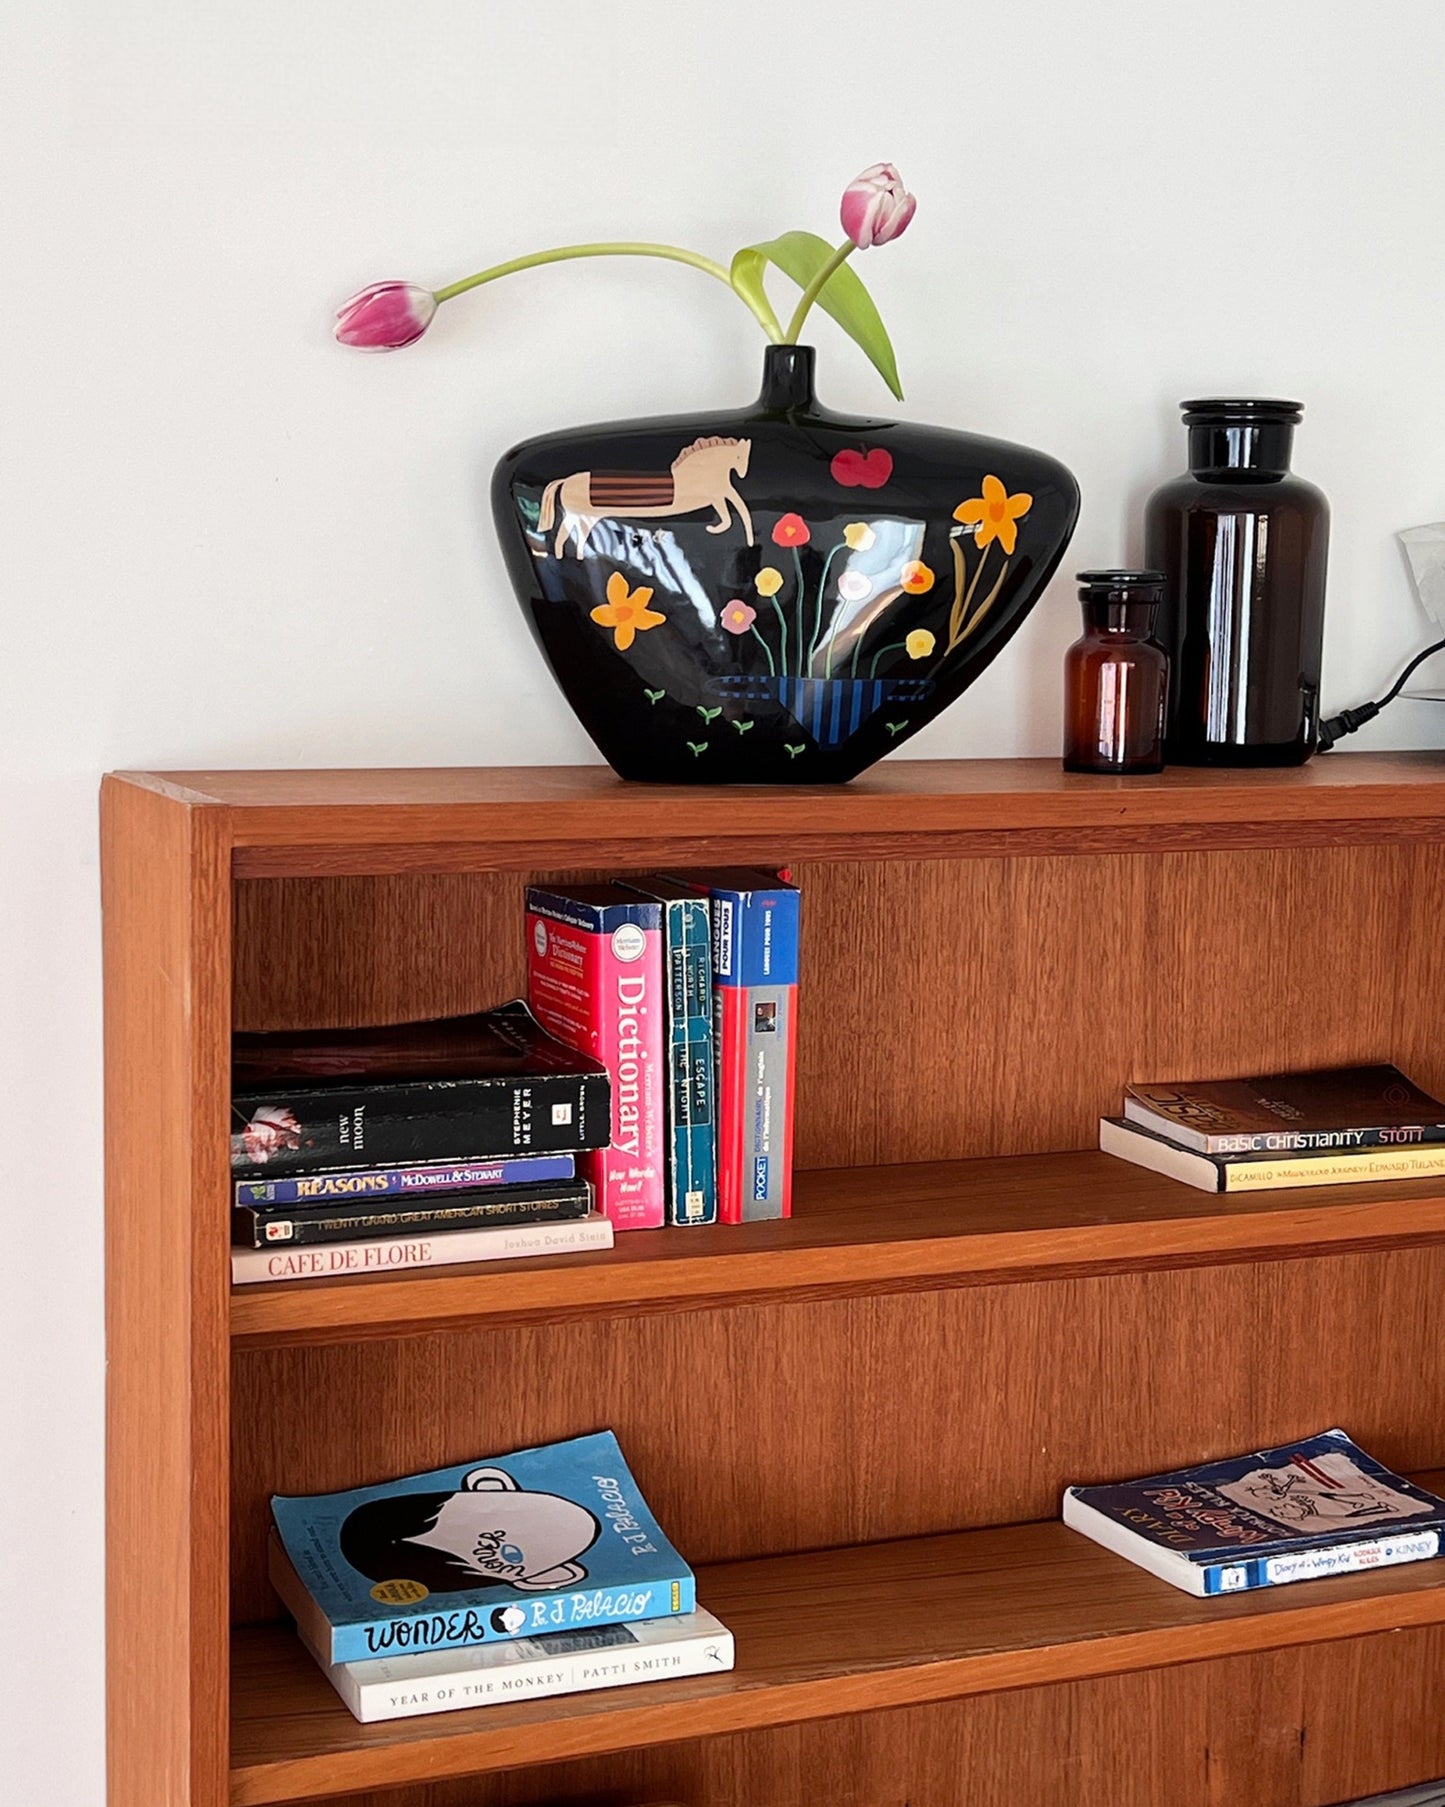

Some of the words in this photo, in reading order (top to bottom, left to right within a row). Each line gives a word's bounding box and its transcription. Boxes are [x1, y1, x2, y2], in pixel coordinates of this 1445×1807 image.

[713, 900, 721, 974] LANGUES
[722, 940, 730, 970] POUR
[673, 953, 683, 1012] PATTERSON
[687, 964, 696, 997] NORTH
[697, 957, 706, 1002] RICHARD
[611, 973, 649, 1157] Dictionary
[694, 1058, 706, 1106] ESCAPE
[339, 1114, 350, 1144] new
[353, 1105, 366, 1150] moon
[513, 1088, 521, 1145] STEPHENIE
[522, 1088, 532, 1145] MEYER
[1378, 1129, 1425, 1144] STOTT
[452, 1170, 463, 1183] &
[756, 1157, 767, 1200] POCKET
[1369, 1162, 1409, 1173] EDWARD
[296, 1174, 389, 1197] REASONS
[317, 1218, 360, 1231] TWENTY
[400, 1211, 431, 1223] GREAT
[433, 1206, 484, 1220] AMERICAN
[486, 1203, 517, 1216] SHORT
[519, 1201, 560, 1212] STORIES
[544, 1234, 576, 1246] David
[268, 1253, 324, 1277] CAFE
[330, 1249, 360, 1270] DE
[364, 1242, 432, 1267] FLORE
[1112, 1506, 1196, 1544] DIARY
[1274, 1562, 1298, 1577] Diary
[1338, 1553, 1351, 1564] Kid
[1395, 1541, 1432, 1554] KINNEY
[389, 1692, 430, 1707] YEAR
[436, 1688, 456, 1700] OF
[464, 1683, 495, 1696] THE
[501, 1673, 565, 1690] MONKEY
[582, 1664, 627, 1679] PATTI
[634, 1656, 682, 1673] SMITH
